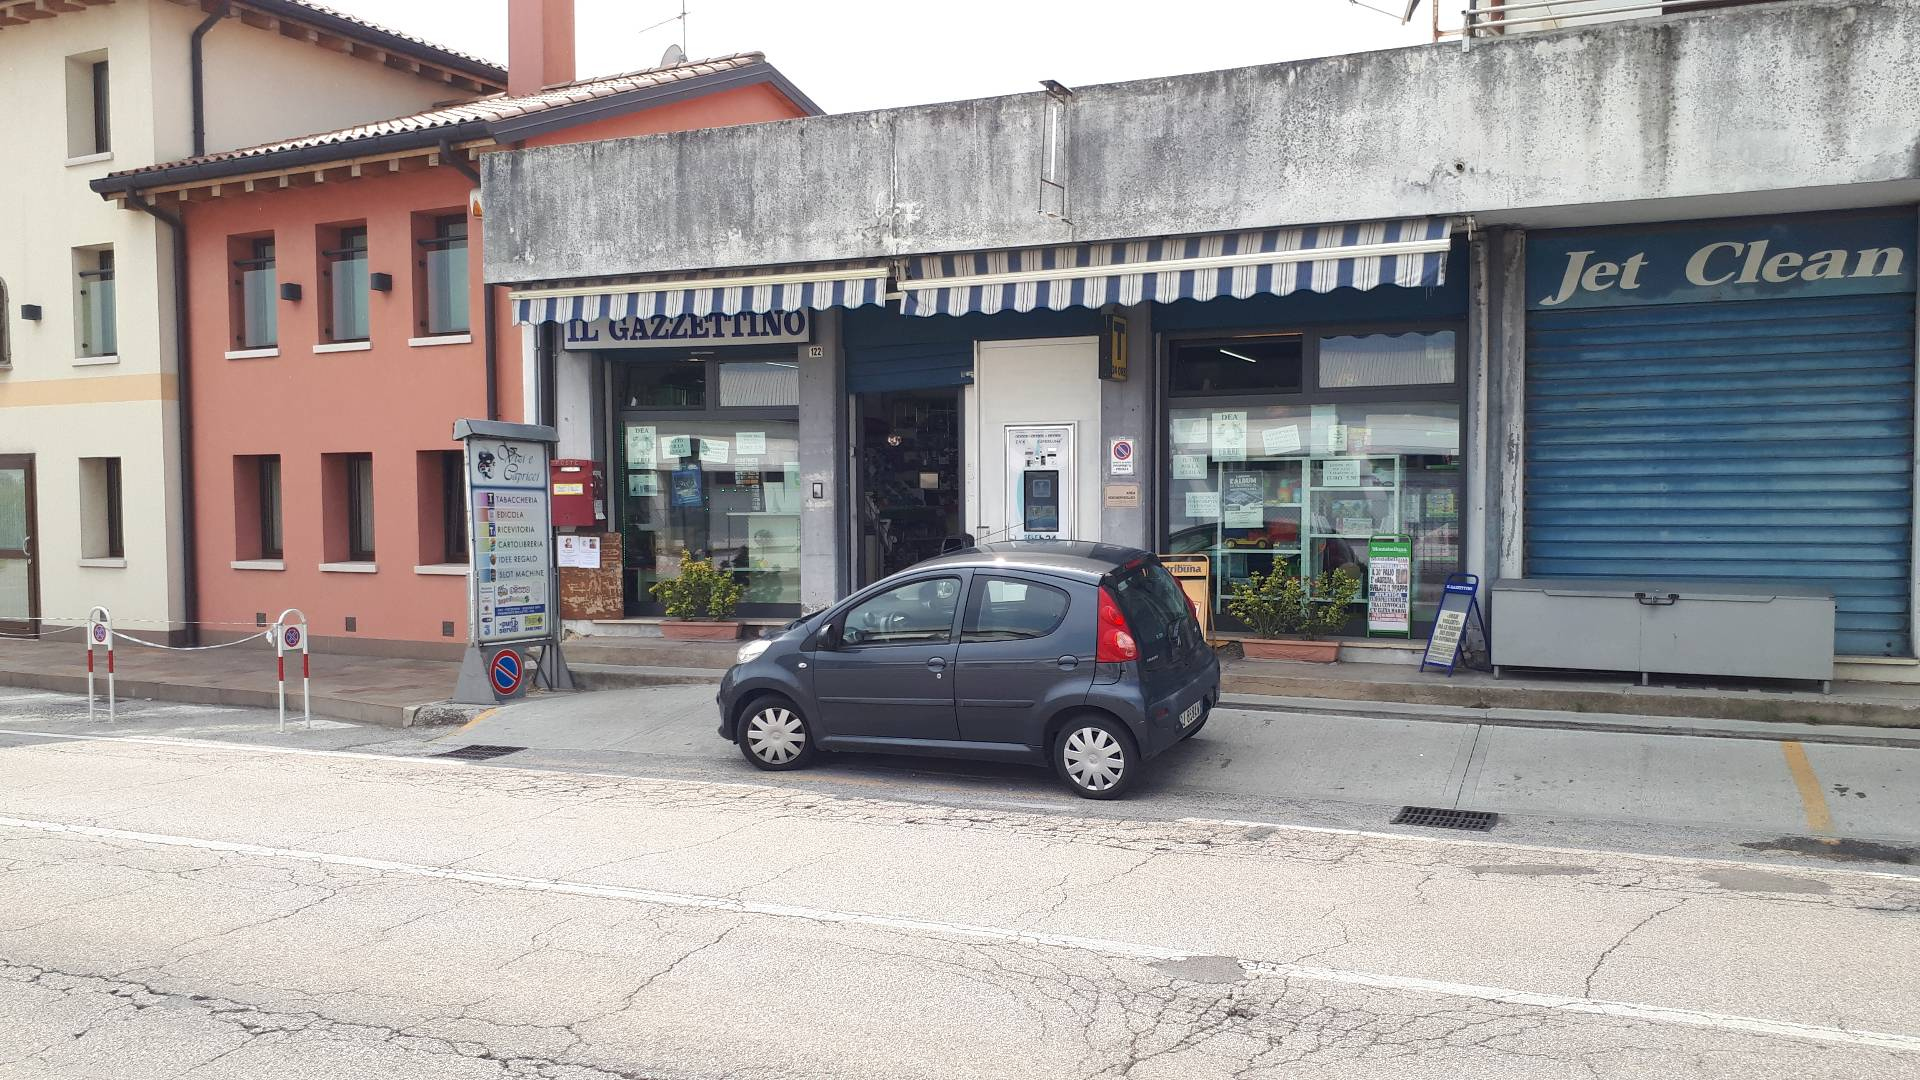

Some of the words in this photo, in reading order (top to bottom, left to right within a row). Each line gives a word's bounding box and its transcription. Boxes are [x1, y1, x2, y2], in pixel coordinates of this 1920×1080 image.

[1538, 249, 1650, 306] Jet
[1685, 239, 1904, 286] Clean
[567, 317, 599, 342] IL
[608, 310, 806, 341] GAZZETTINO
[811, 347, 822, 357] 122
[504, 463, 540, 483] Capricci
[496, 495, 538, 504] TABACCHERIA
[496, 511, 524, 519] EDICOLA
[497, 526, 535, 534] RICEVITORIA
[498, 540, 544, 549] CARTOLIBRERIA
[498, 555, 513, 563] IDEE
[514, 555, 538, 563] REGALO
[499, 570, 513, 579] SLOT
[515, 569, 545, 578] MACHINE
